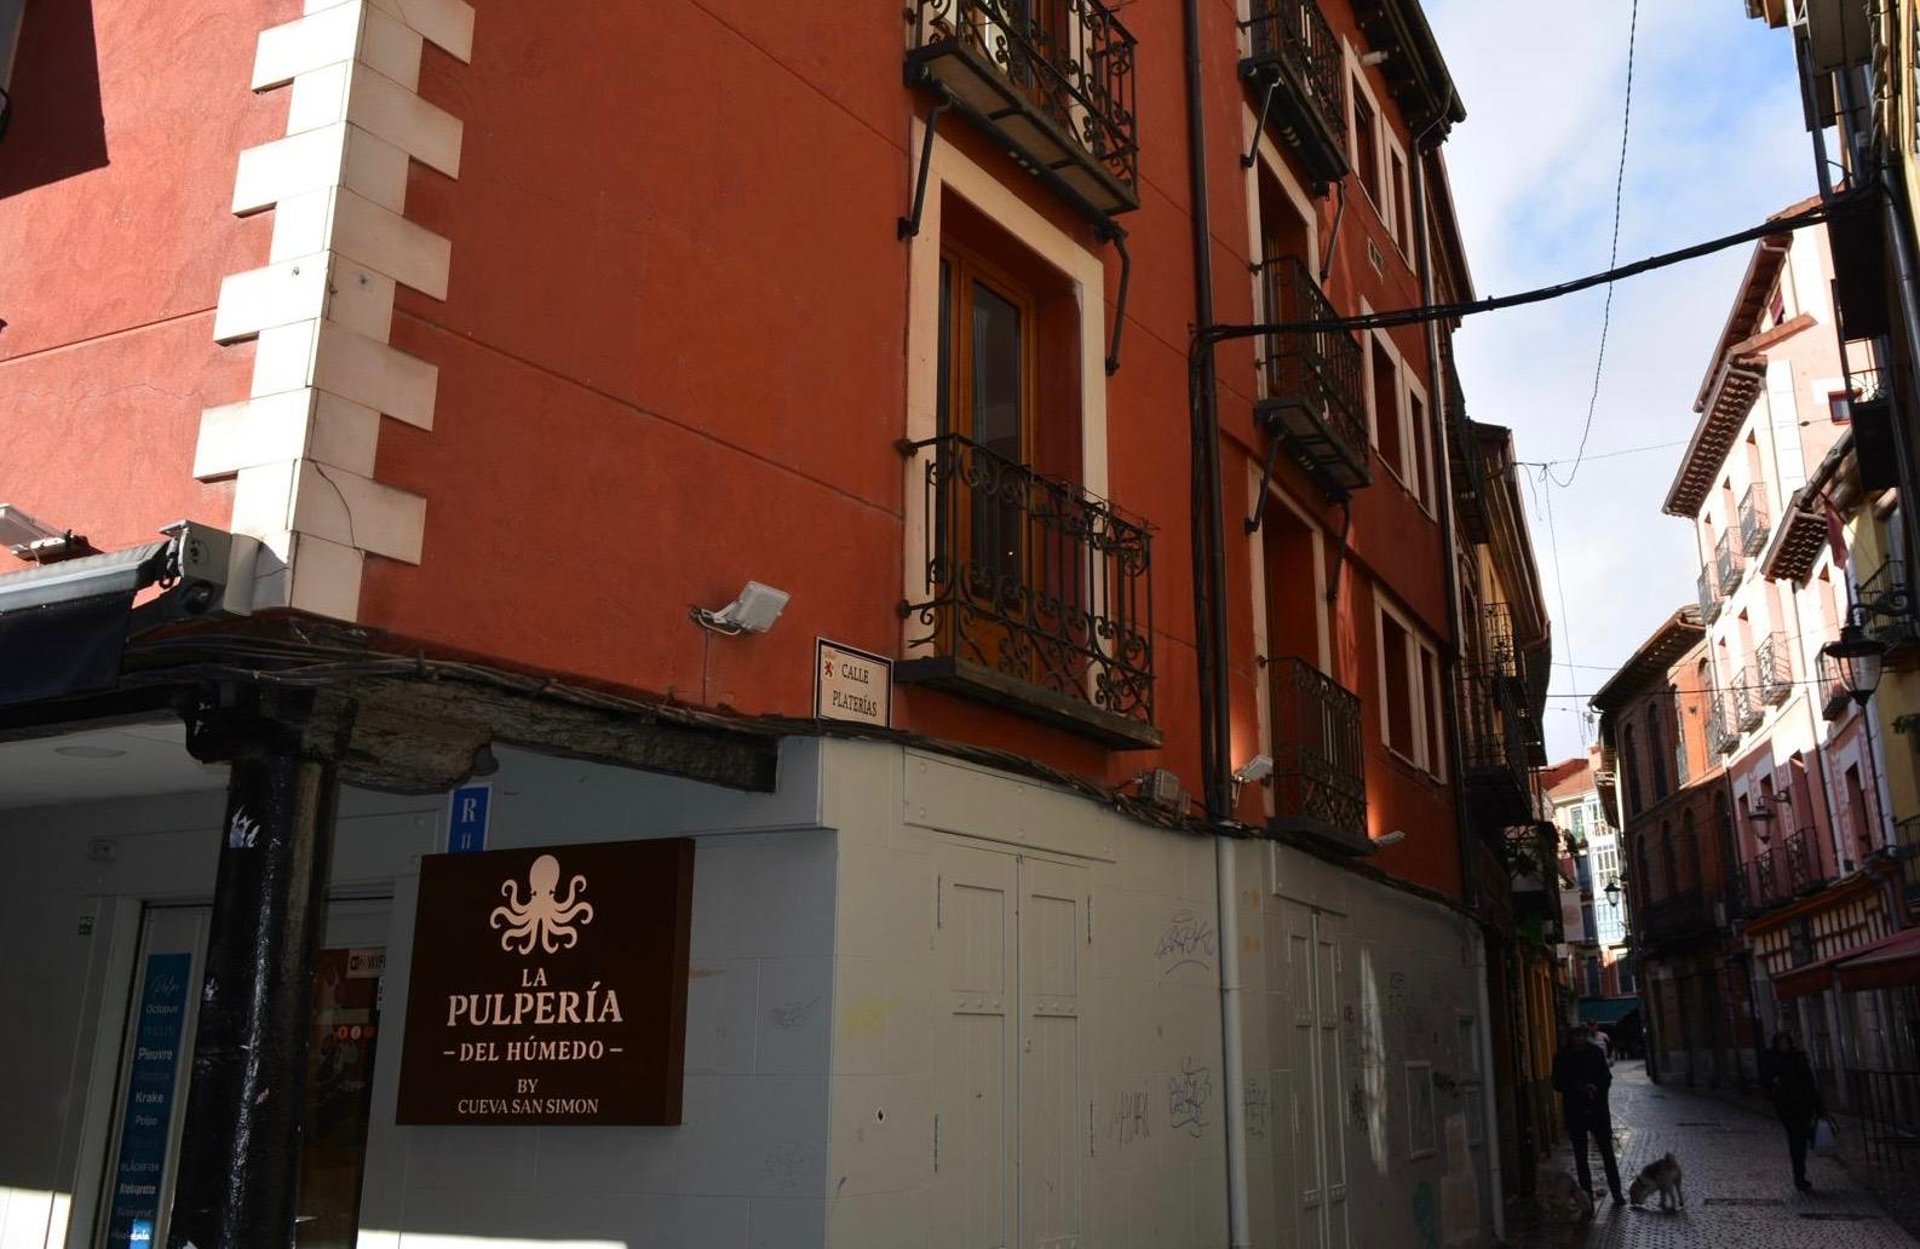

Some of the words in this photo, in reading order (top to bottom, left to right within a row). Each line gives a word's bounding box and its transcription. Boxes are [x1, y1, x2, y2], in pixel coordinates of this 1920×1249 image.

[841, 663, 869, 684] CALLE
[832, 690, 877, 717] PLATERÍAS
[461, 797, 478, 824] R
[521, 967, 548, 988] LA
[446, 981, 624, 1027] PULPERÍA
[459, 1042, 500, 1062] DEL
[506, 1036, 604, 1061] HÚMEDO
[517, 1078, 539, 1094] BY
[135, 1091, 164, 1105] Krake
[458, 1099, 508, 1114] CUEVA
[511, 1099, 543, 1114] SAN
[546, 1099, 599, 1114] SIMON
